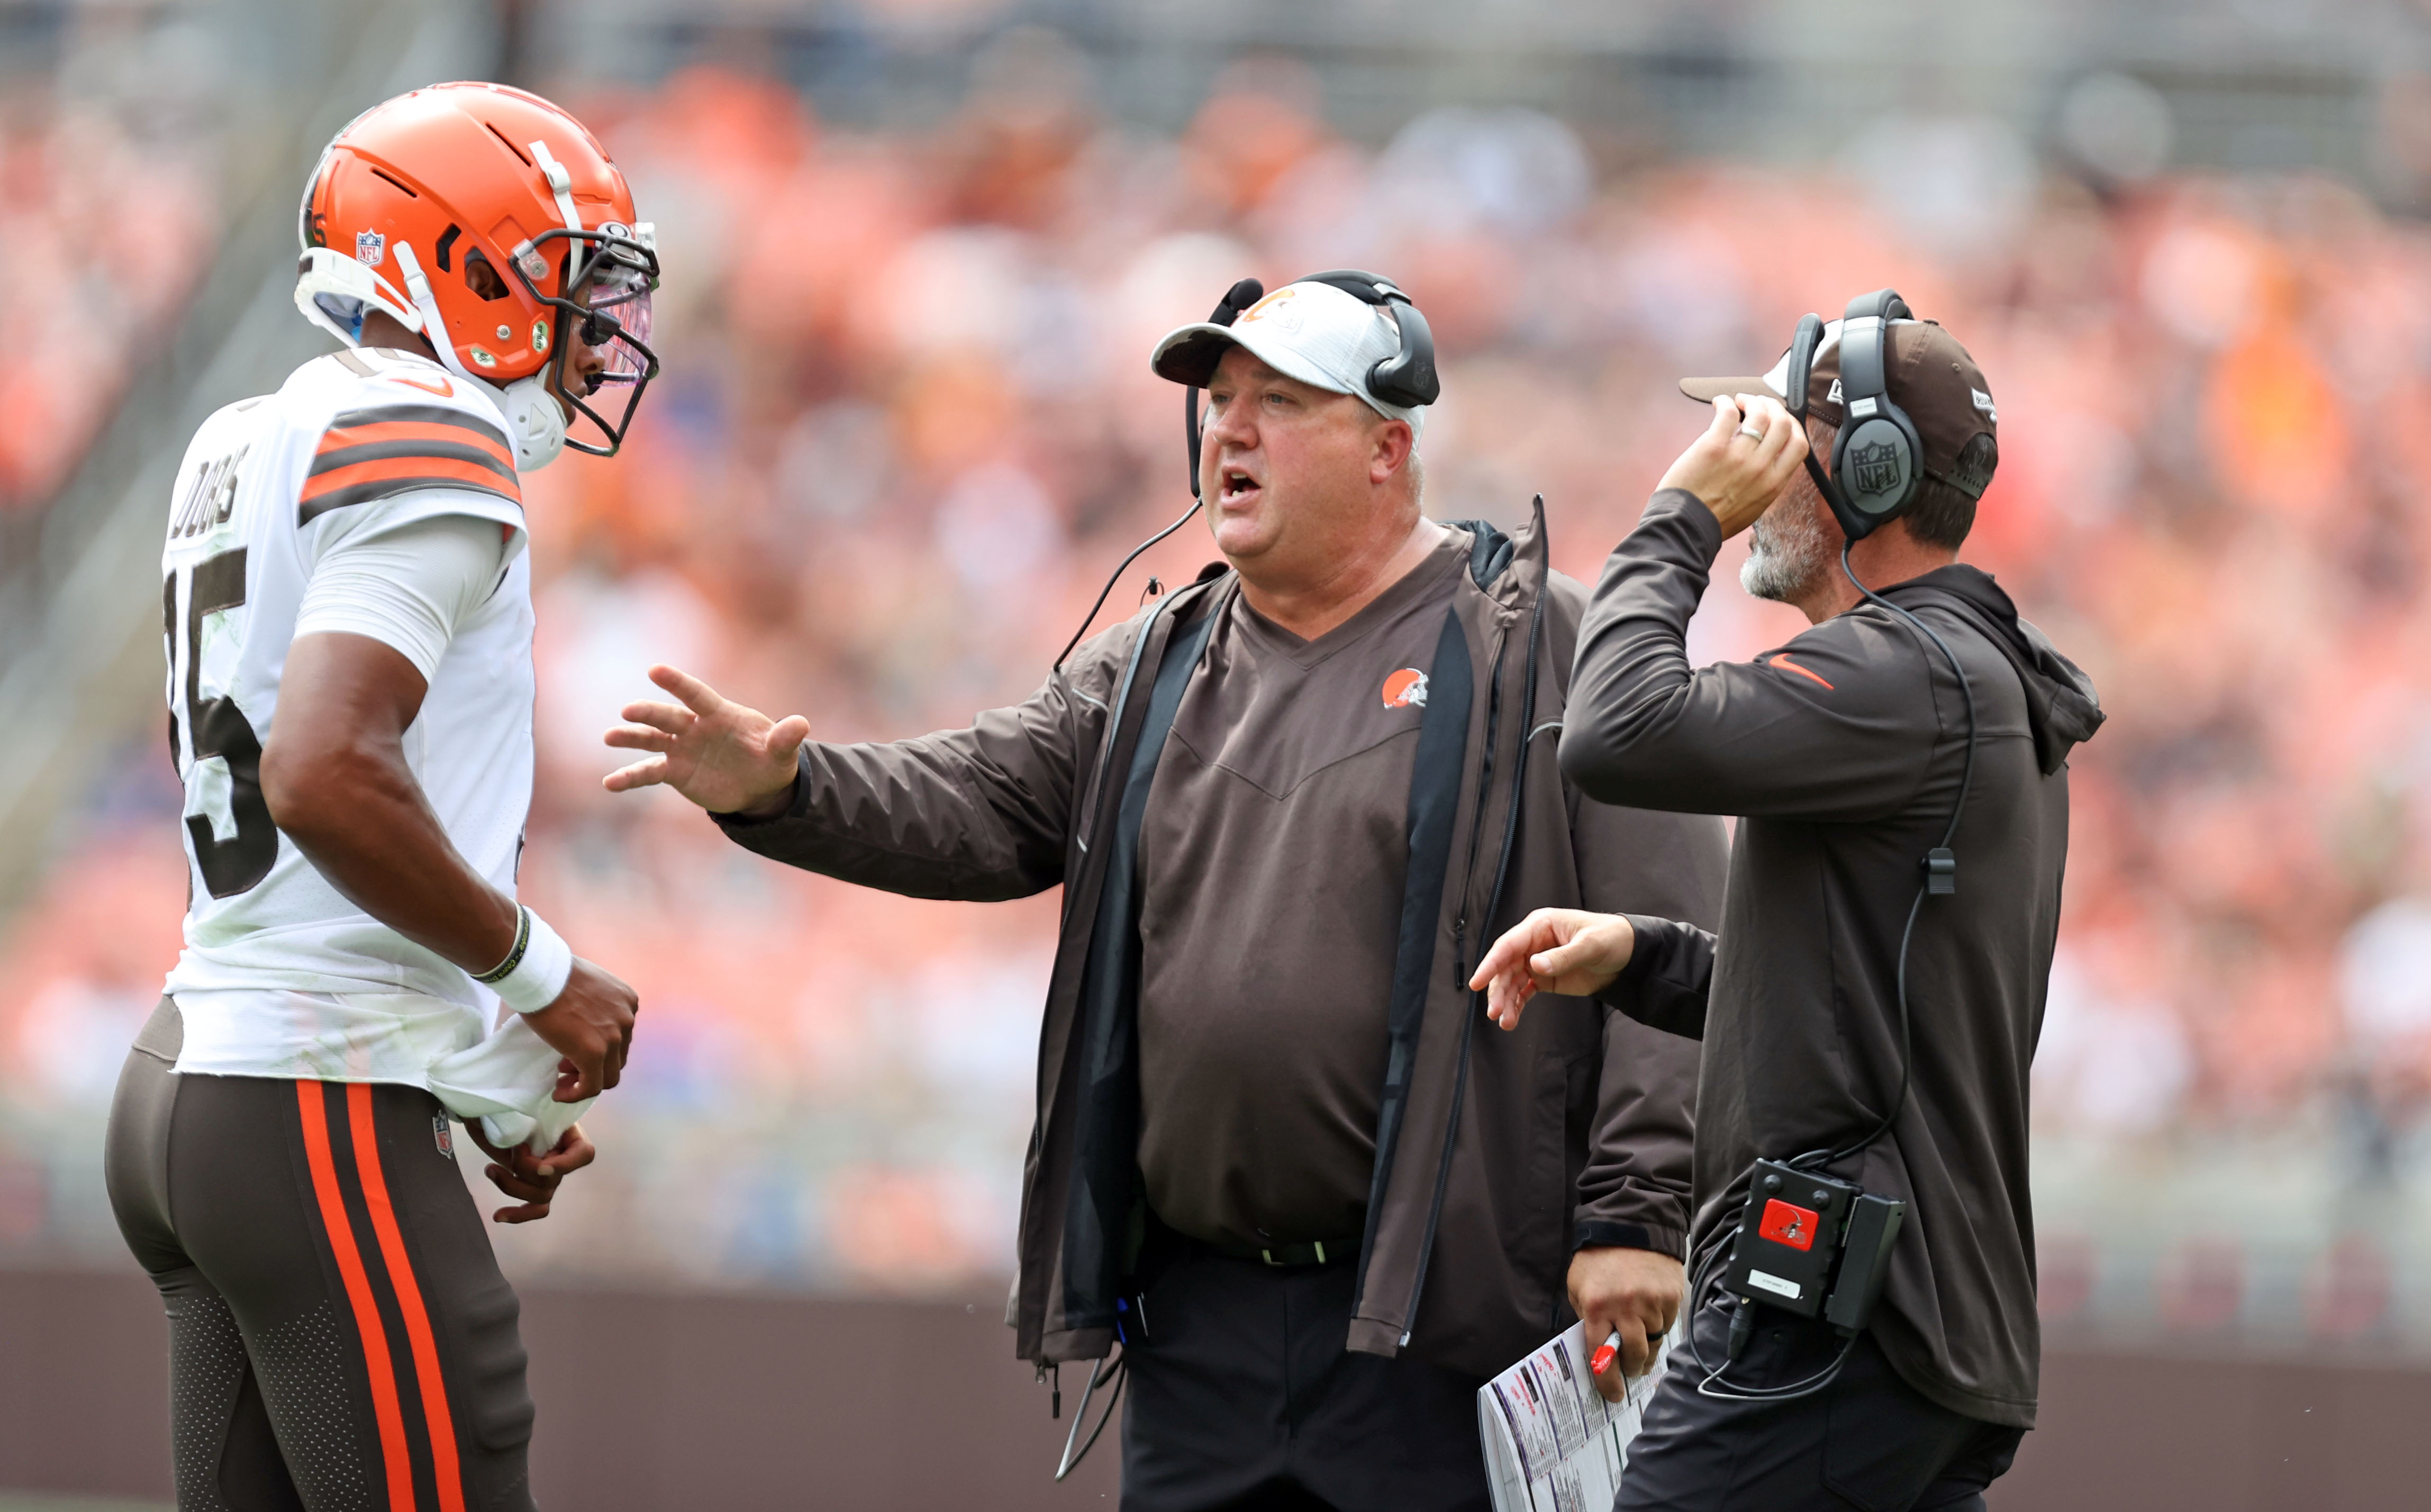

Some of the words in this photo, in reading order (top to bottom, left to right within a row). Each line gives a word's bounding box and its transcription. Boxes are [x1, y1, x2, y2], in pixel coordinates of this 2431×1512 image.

[360, 245, 377, 261] NFL
[1858, 462, 1897, 489] NFL
[169, 442, 250, 540] DOBS
[498, 959, 516, 978] Coach
